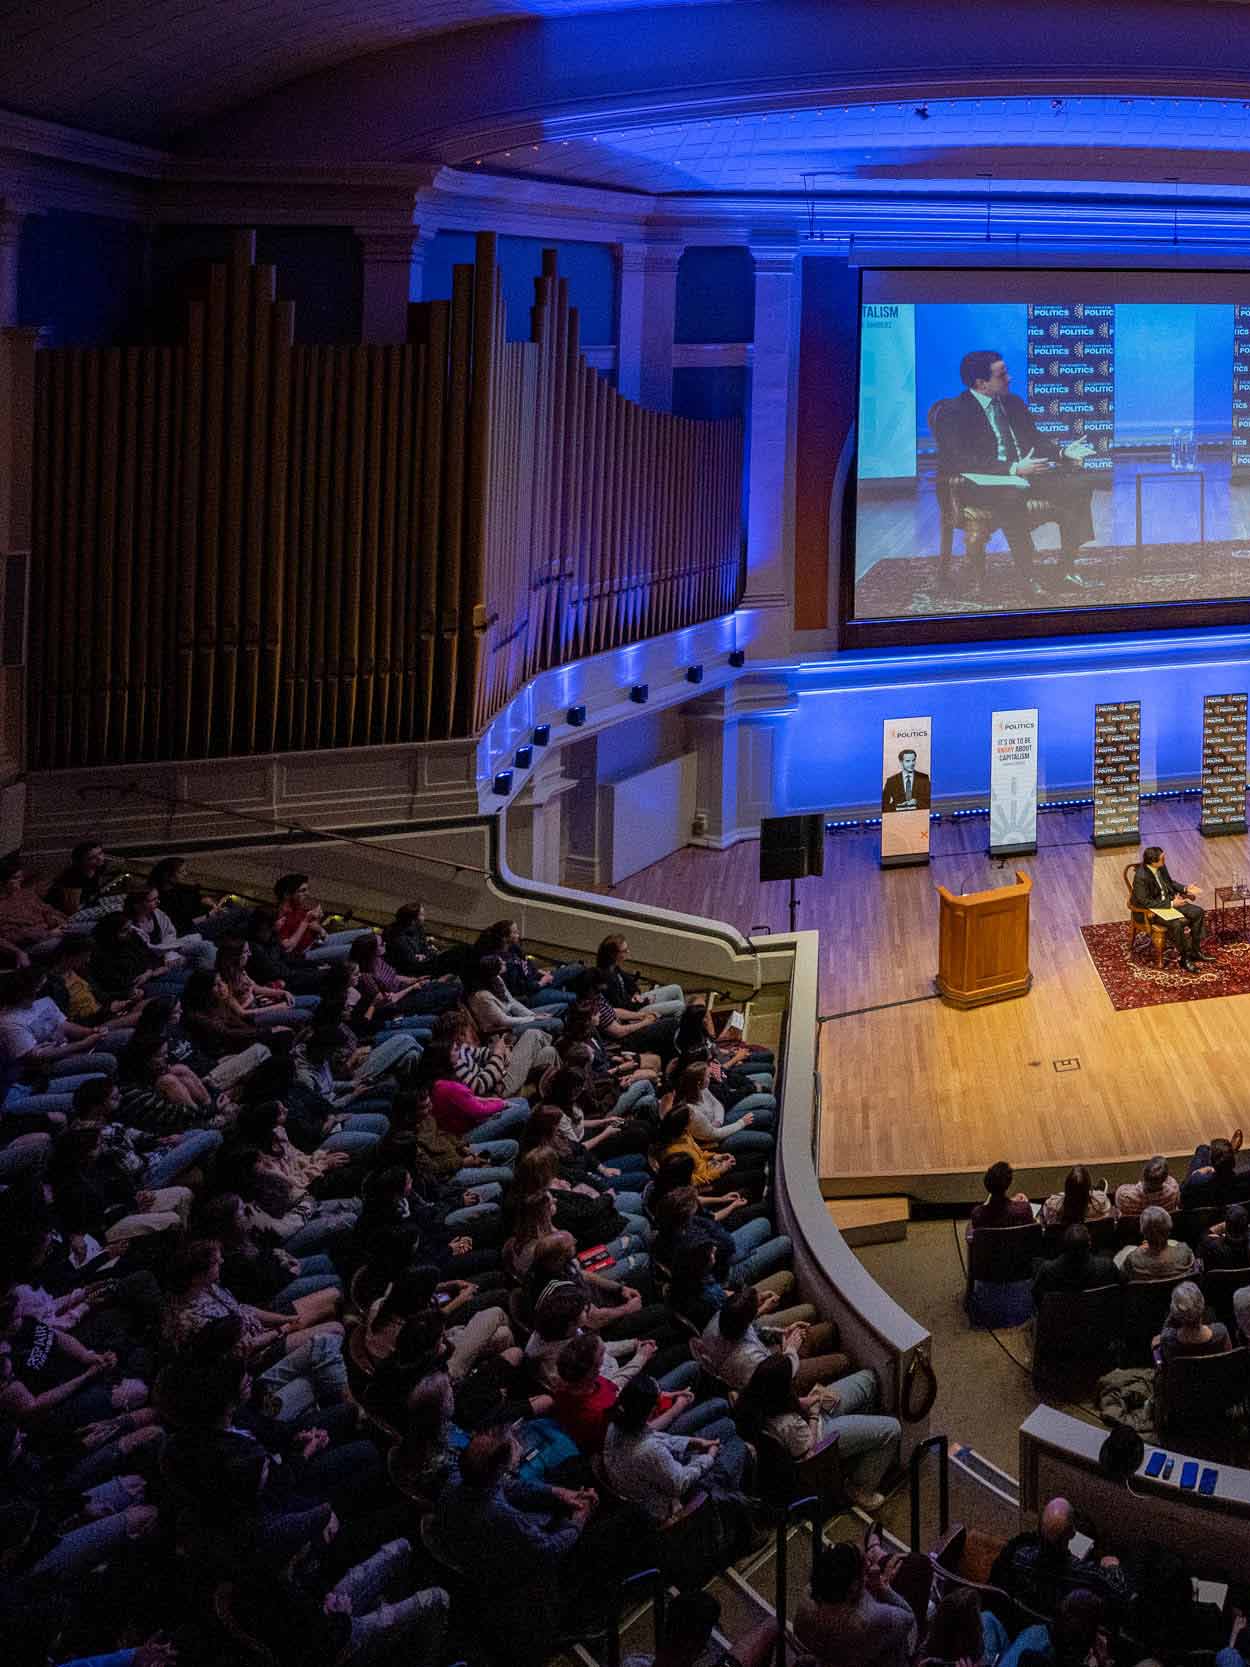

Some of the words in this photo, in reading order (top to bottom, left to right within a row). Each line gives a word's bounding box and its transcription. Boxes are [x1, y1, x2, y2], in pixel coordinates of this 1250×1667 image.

[1034, 309, 1069, 317] POLITICS
[1060, 328, 1094, 336] POLITICS
[1034, 386, 1069, 394] POLITICS
[896, 730, 928, 738] POLITICS
[1000, 753, 1030, 761] CAPITALISM
